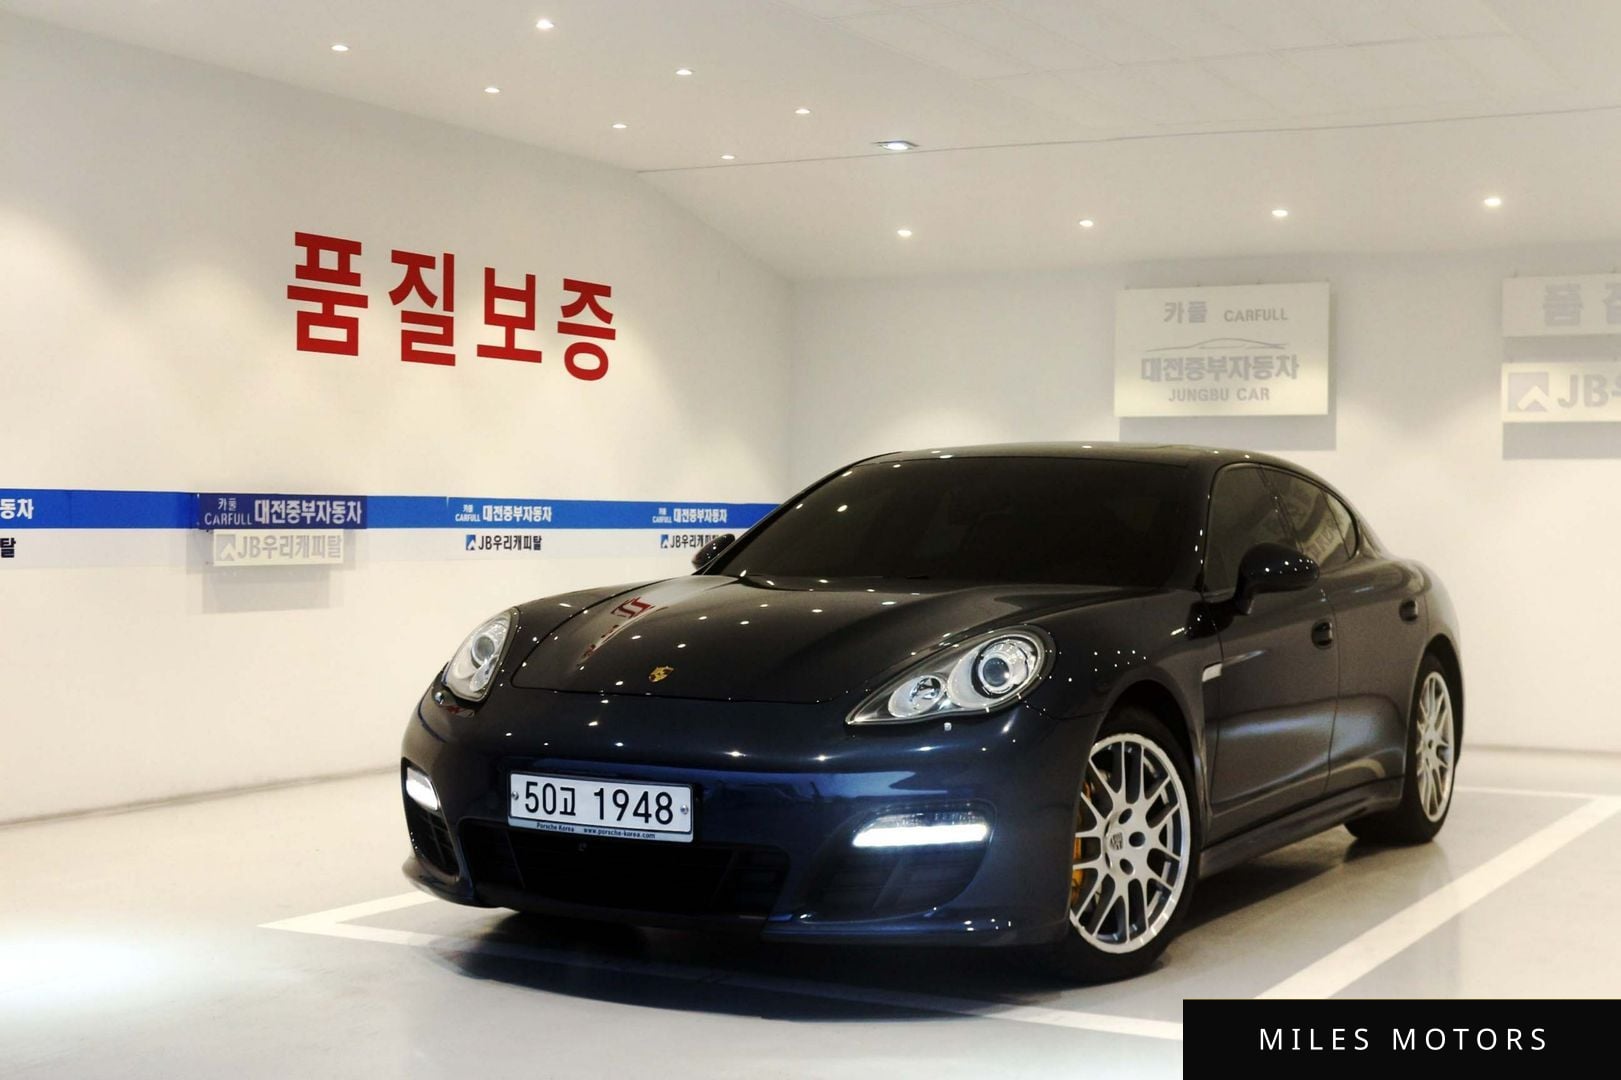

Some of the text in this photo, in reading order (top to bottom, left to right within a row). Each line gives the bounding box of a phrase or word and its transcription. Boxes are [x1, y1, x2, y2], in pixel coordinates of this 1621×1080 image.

[287, 232, 616, 381] 품질보증
[1223, 308, 1288, 322] CARFULL
[1141, 354, 1299, 382] 대전중부자동차
[1168, 387, 1270, 402] JUNGBU CAR
[204, 512, 252, 526] CARFULL
[254, 499, 362, 525] 대전중부자동차
[482, 505, 552, 522] 대전중부자동차
[237, 534, 343, 559] JB우리캐피탈
[478, 535, 542, 551] JB우리캐피탈
[525, 780, 674, 825] 50고 1948
[536, 822, 656, 840] Porsche Korea www.porsche-korea.com
